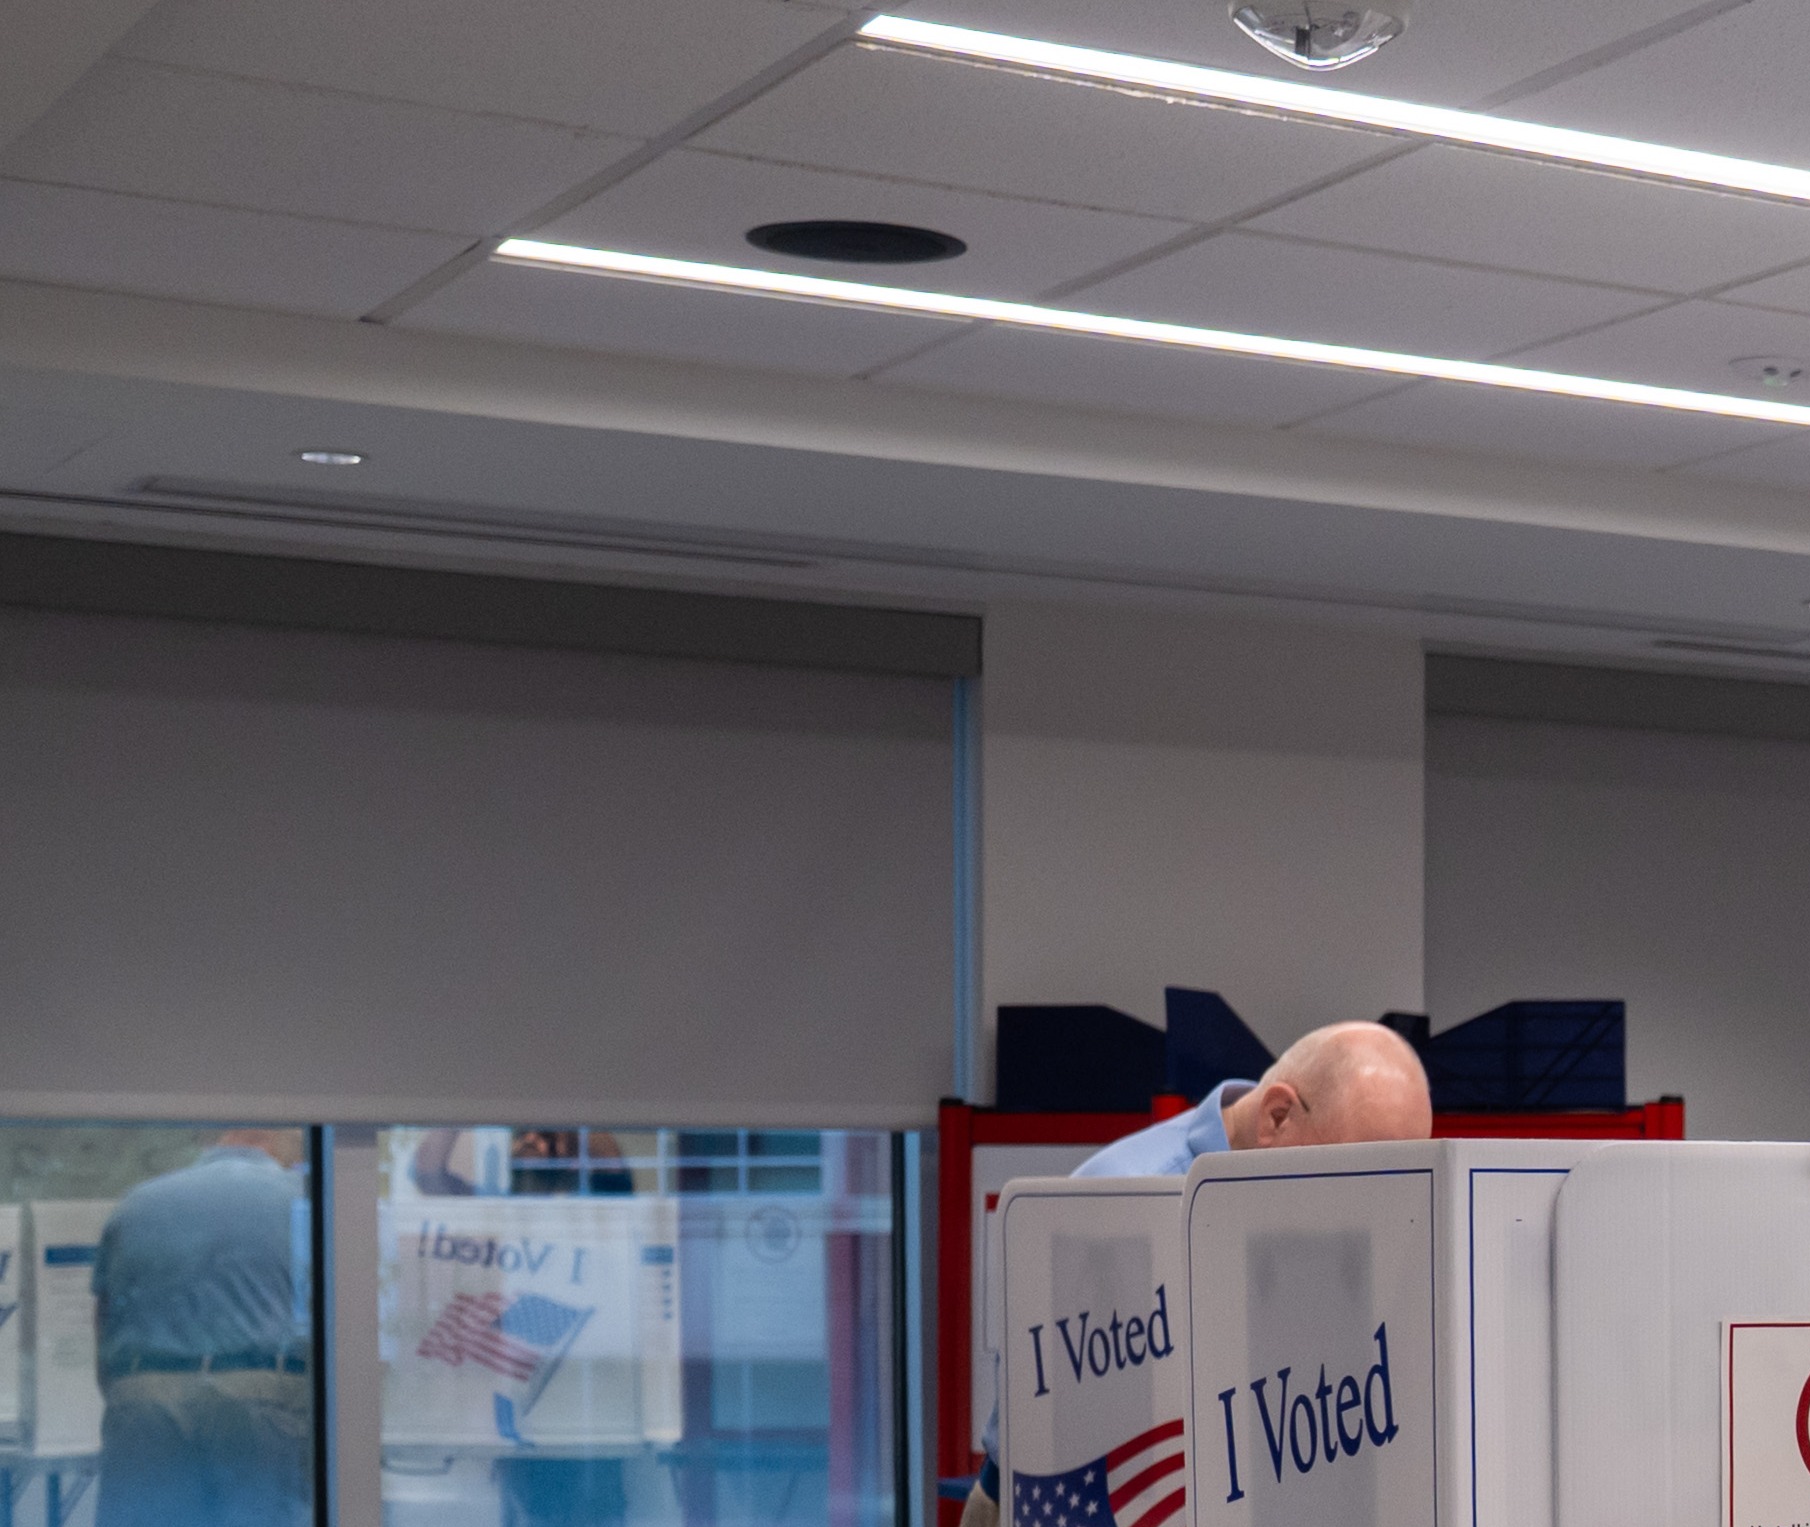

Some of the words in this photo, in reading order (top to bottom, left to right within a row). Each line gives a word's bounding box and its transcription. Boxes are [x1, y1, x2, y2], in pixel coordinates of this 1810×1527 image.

[1029, 1324, 1050, 1397] I
[1055, 1284, 1174, 1382] Voted
[1217, 1387, 1245, 1503] I
[1250, 1323, 1399, 1485] Voted
